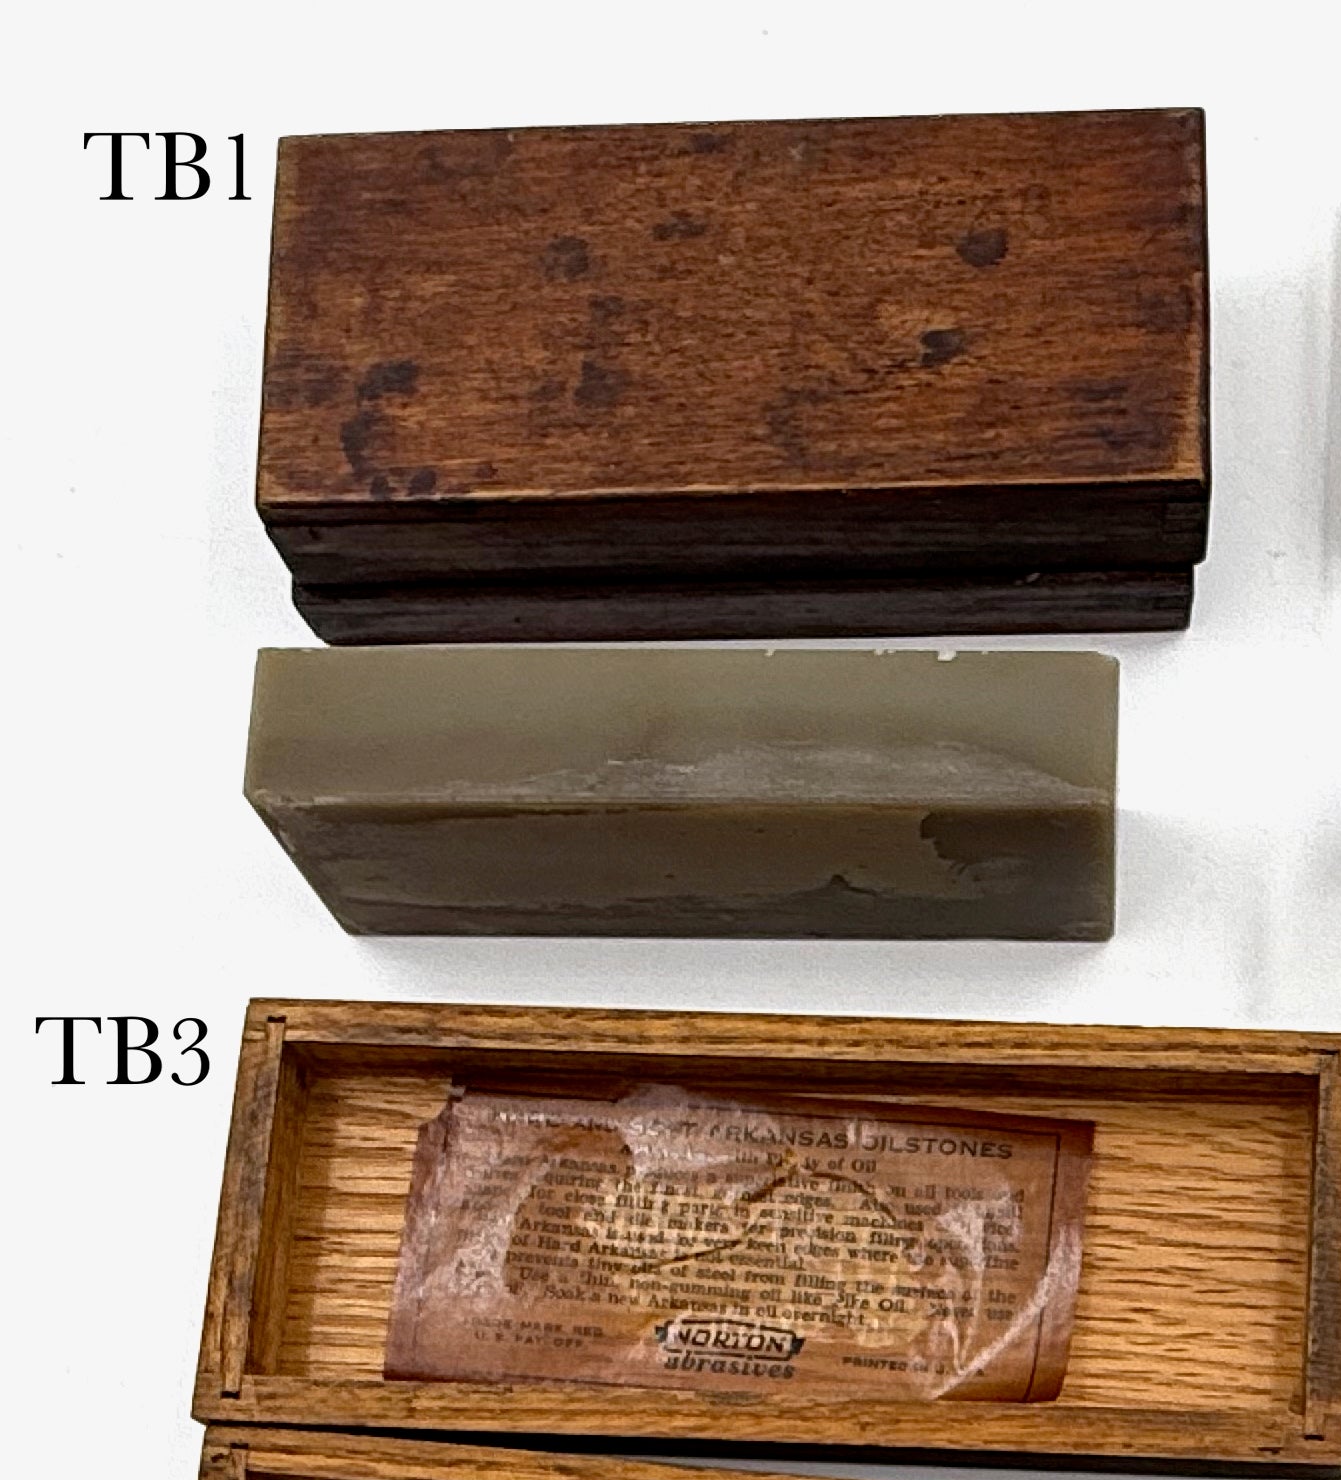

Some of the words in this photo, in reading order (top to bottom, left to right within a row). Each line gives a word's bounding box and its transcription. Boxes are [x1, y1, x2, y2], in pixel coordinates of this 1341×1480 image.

[709, 1122, 848, 1149] ARKANSAS
[827, 1157, 844, 1172] of
[851, 1157, 878, 1174] Oil
[628, 1278, 752, 1301] non-gumming
[790, 1289, 823, 1306] like
[743, 1270, 786, 1286] from
[794, 1273, 847, 1293] filling
[987, 1288, 1018, 1304] the
[676, 1327, 787, 1353] NORTON
[663, 1352, 796, 1380] abrasives
[841, 1355, 907, 1372] PRINTED
